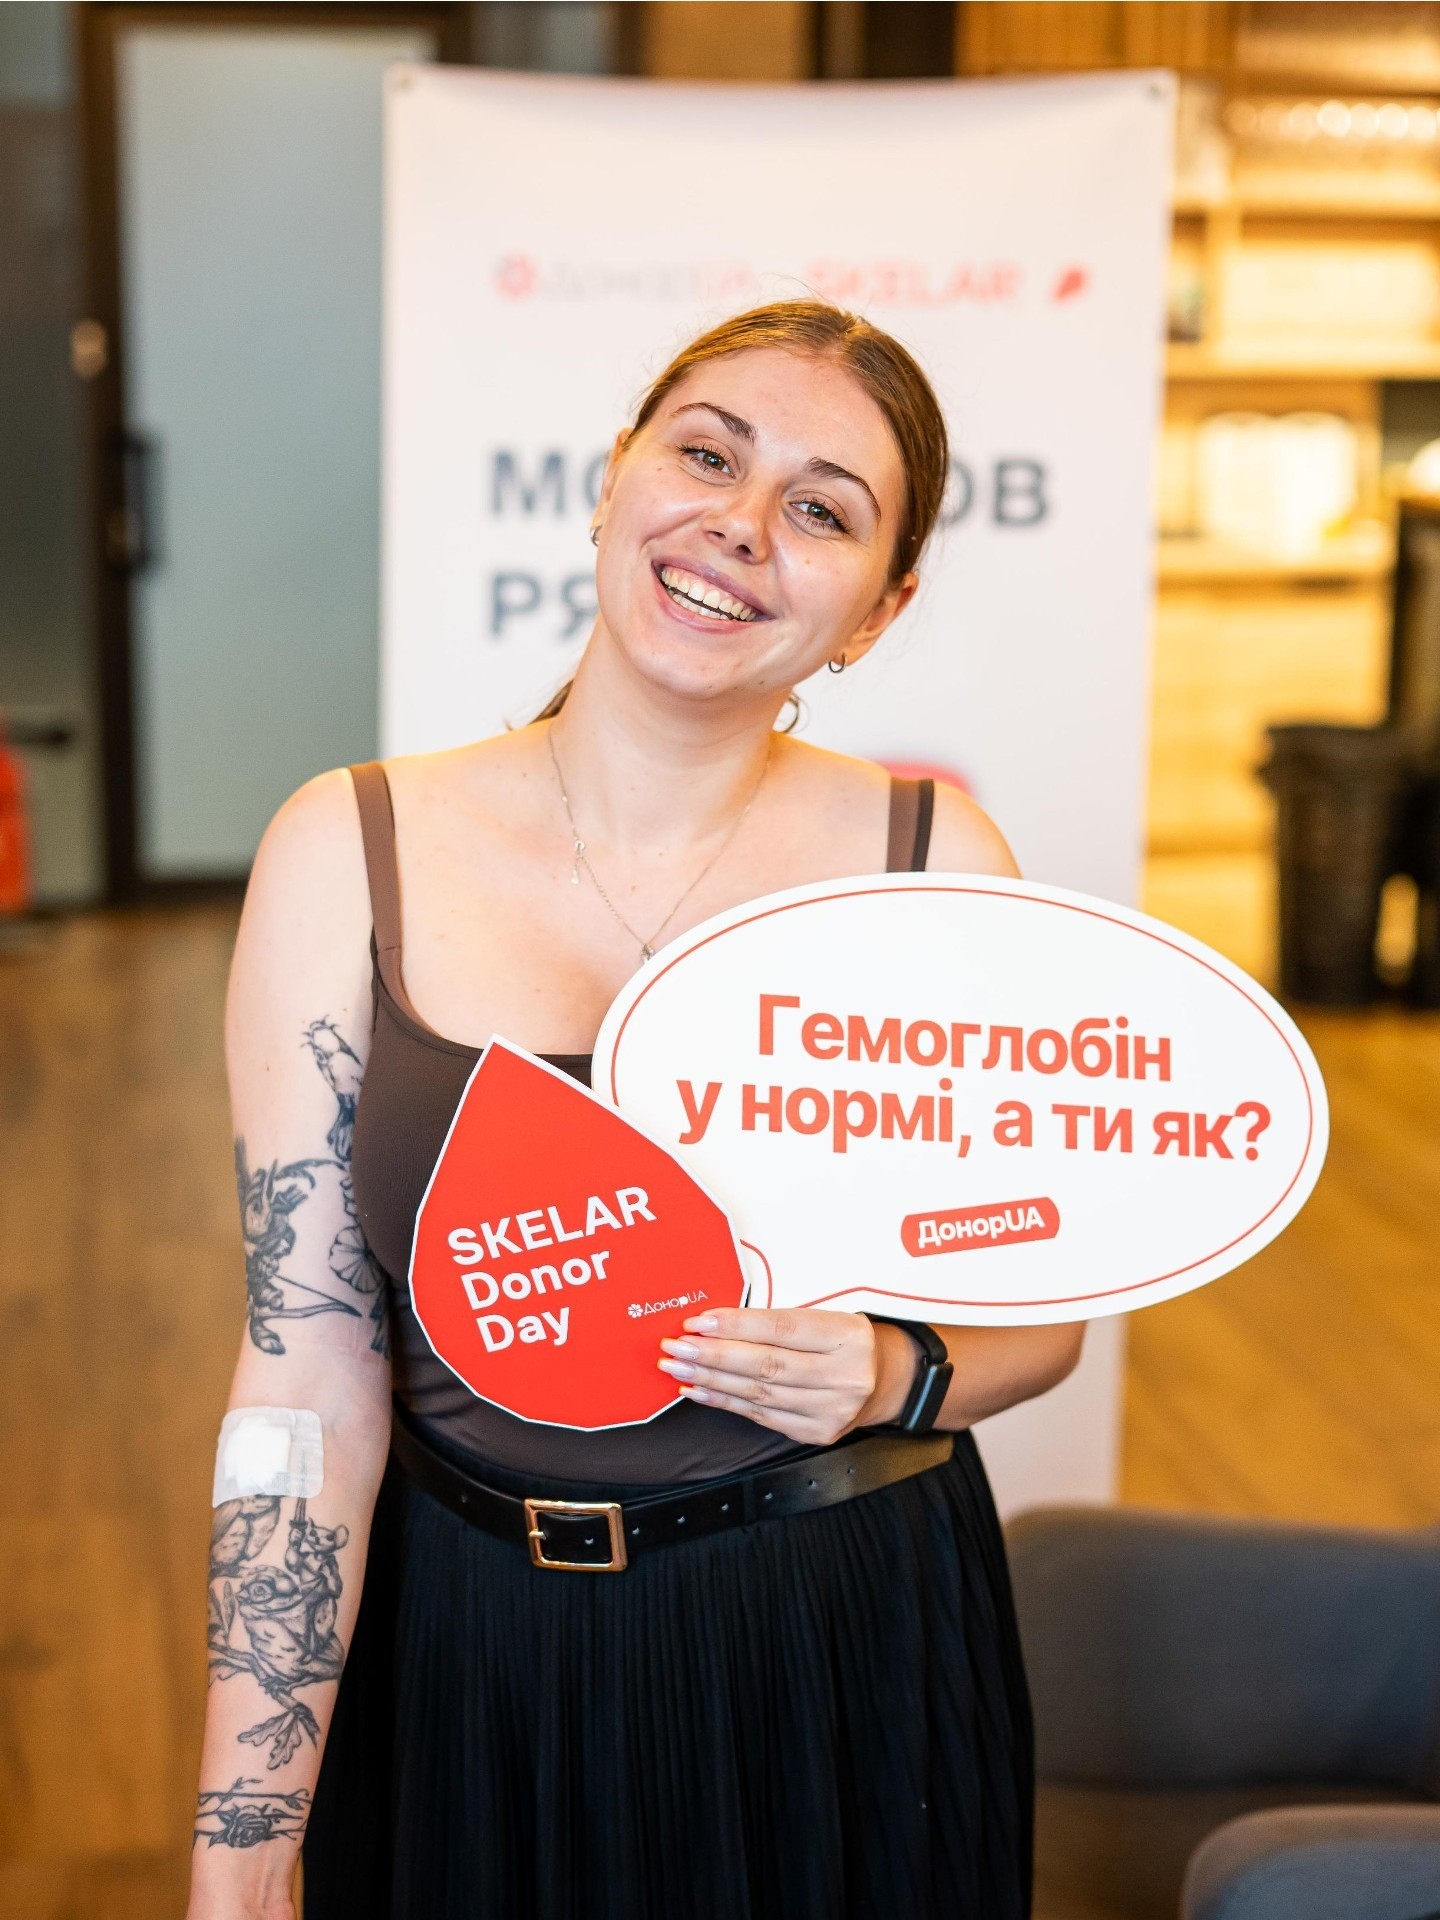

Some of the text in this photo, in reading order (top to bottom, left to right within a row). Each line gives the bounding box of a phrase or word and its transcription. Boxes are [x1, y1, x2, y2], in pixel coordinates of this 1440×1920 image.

[758, 993, 1172, 1083] Гемоглобін
[677, 1077, 1272, 1162] у нормі, а ти як?
[447, 1186, 658, 1266] SKELAR
[460, 1250, 610, 1311] Donor
[475, 1306, 570, 1353] Day
